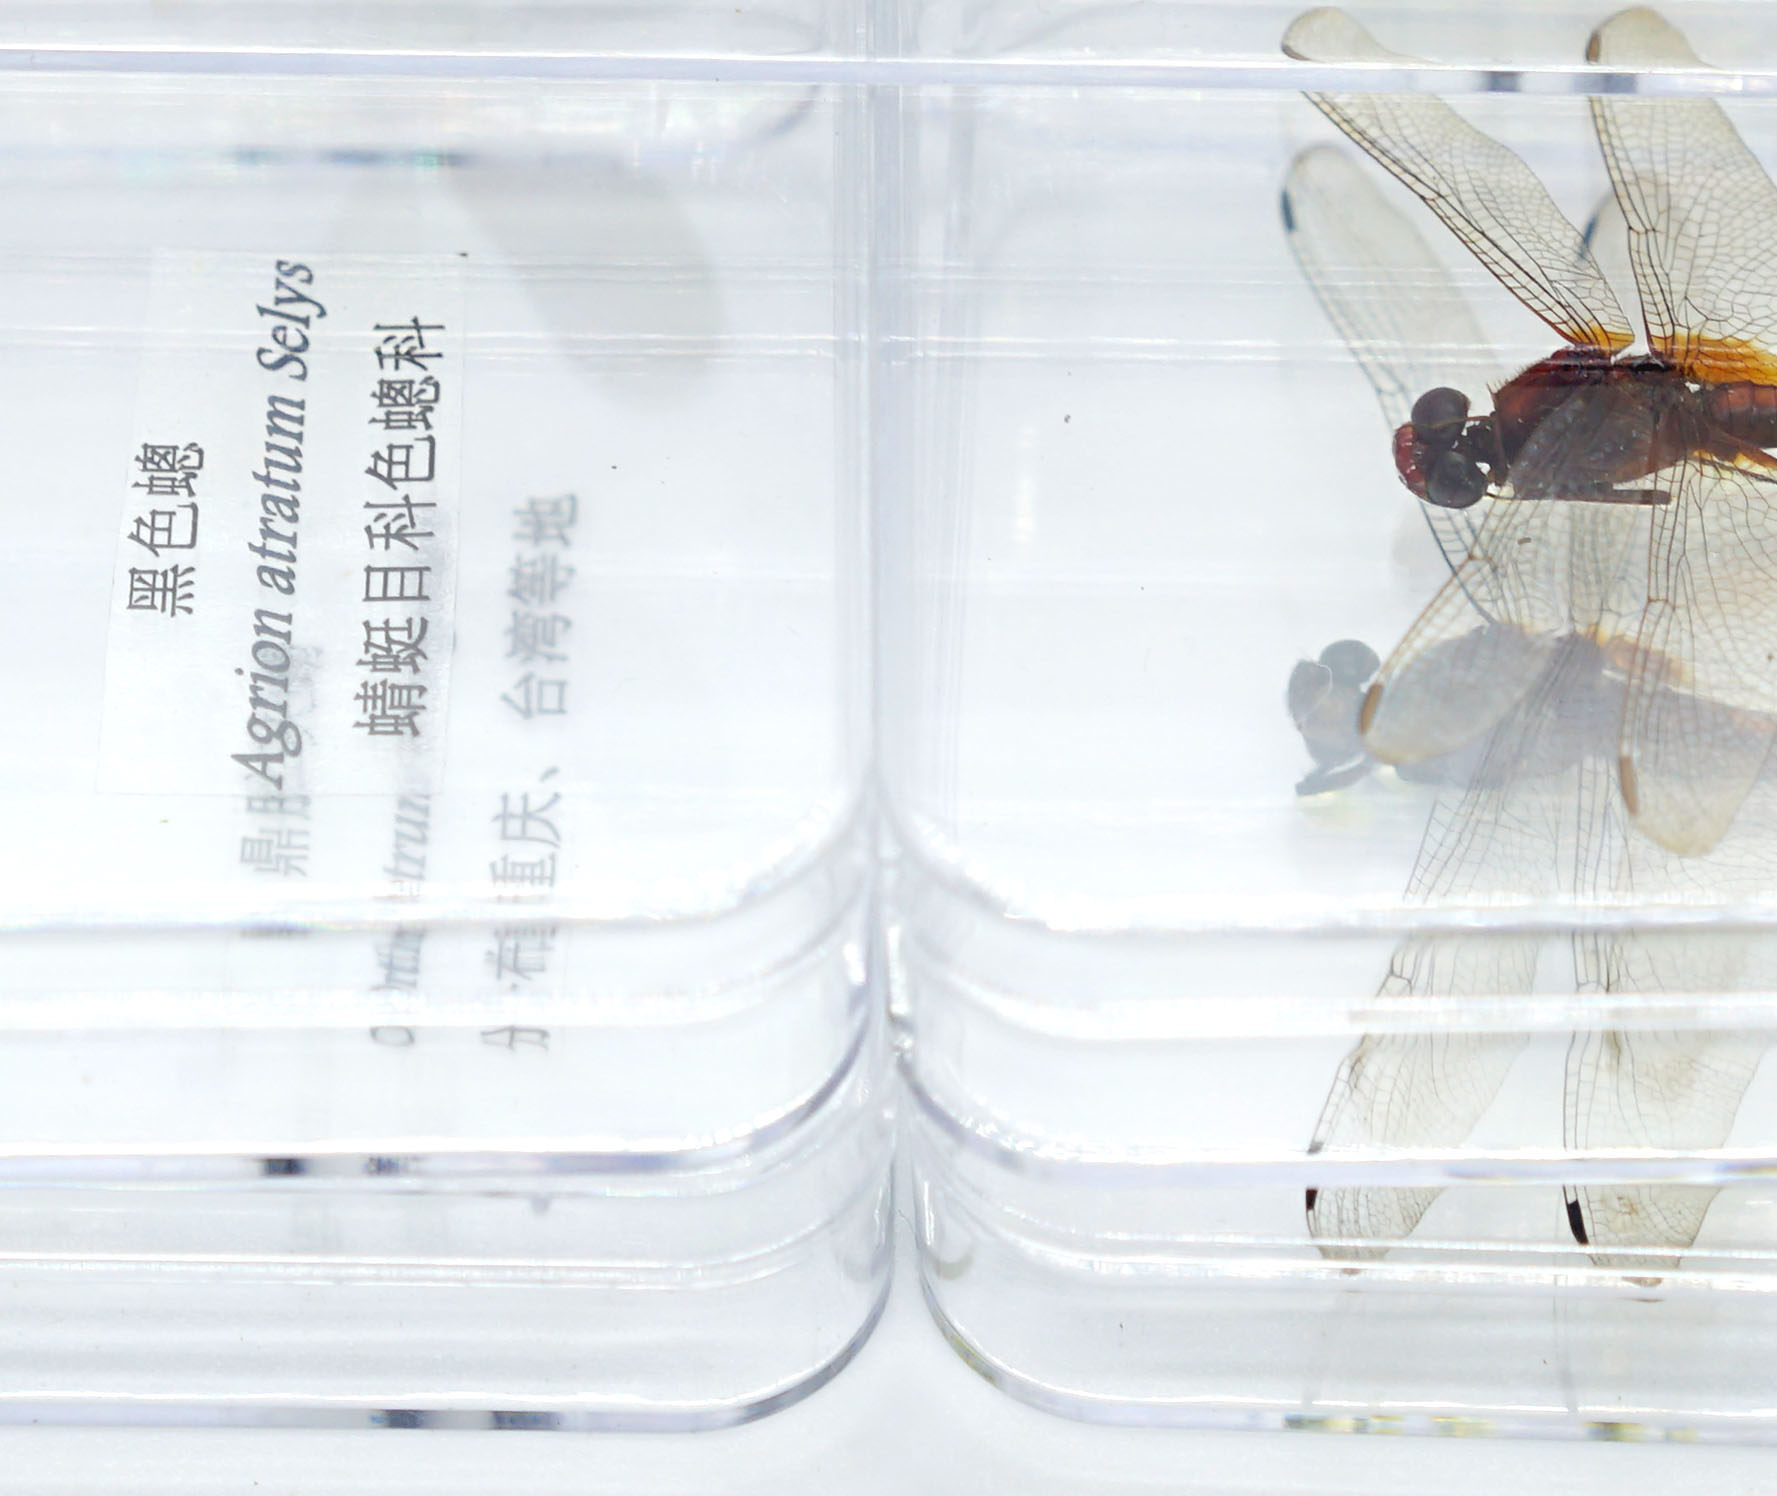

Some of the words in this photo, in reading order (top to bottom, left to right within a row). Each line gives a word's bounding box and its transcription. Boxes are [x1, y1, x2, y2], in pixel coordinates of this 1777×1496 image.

[256, 260, 328, 380] Selys
[248, 395, 309, 595] atratum
[231, 612, 303, 790] Agrion
